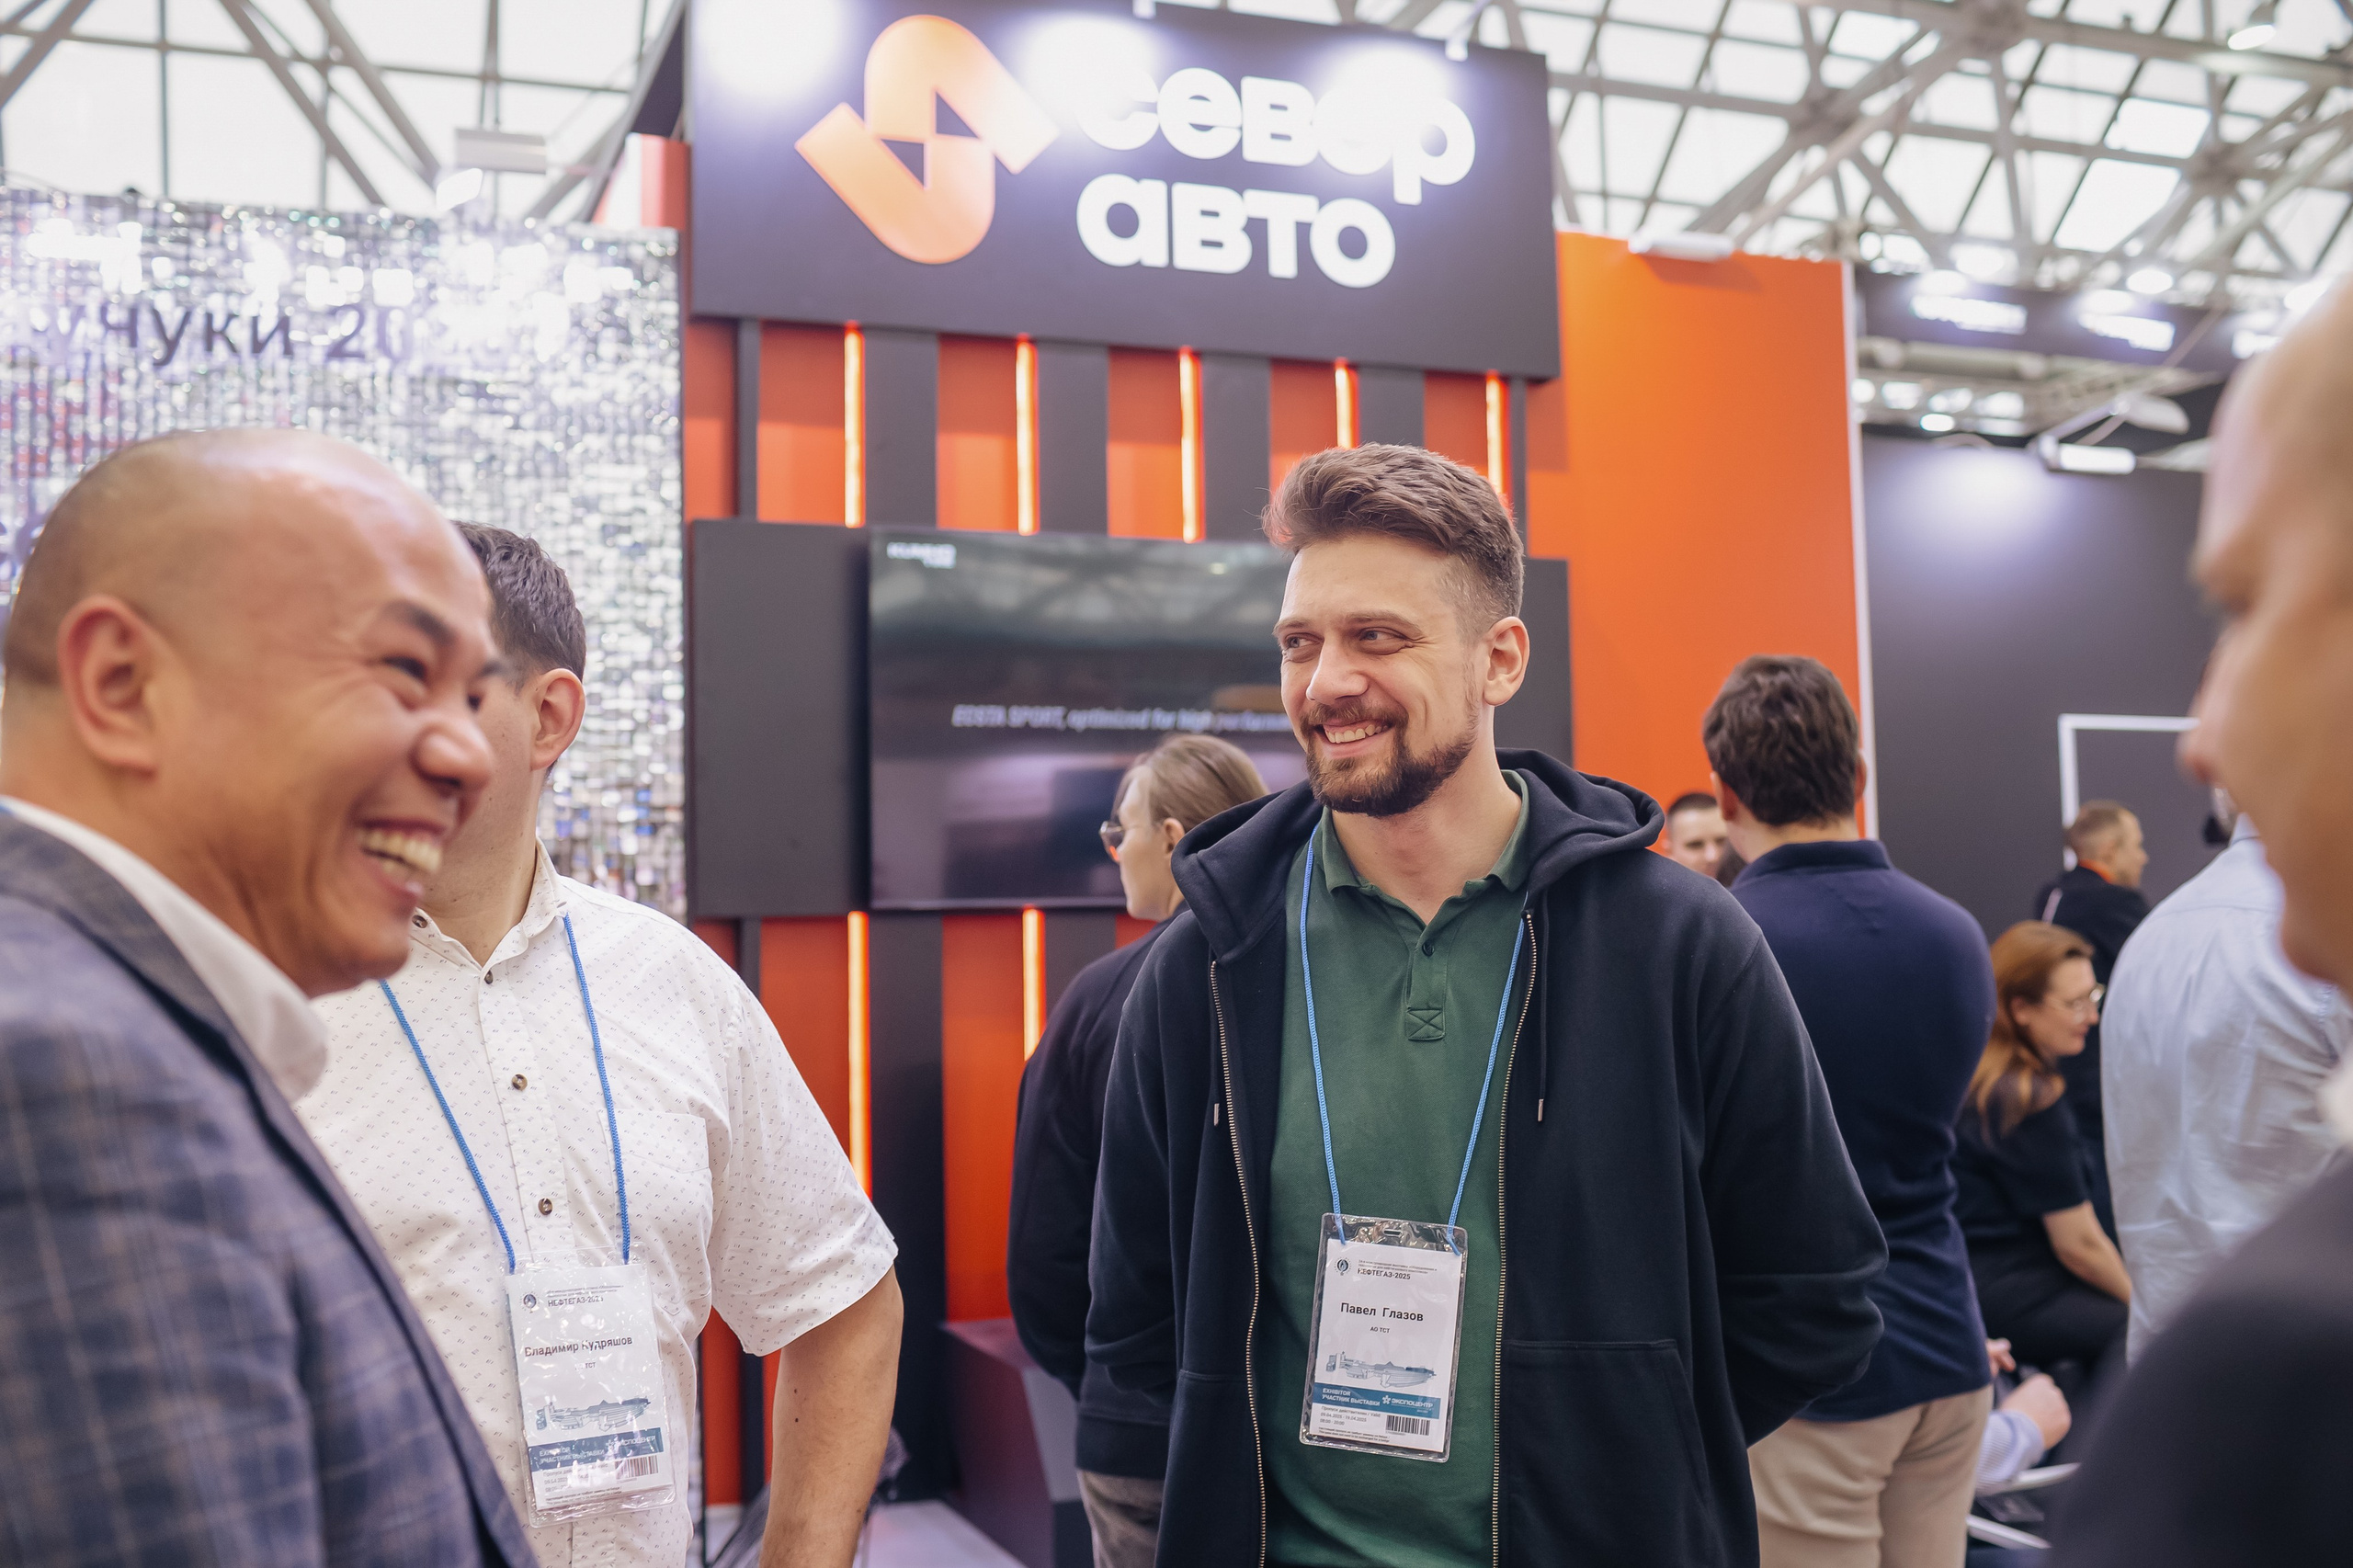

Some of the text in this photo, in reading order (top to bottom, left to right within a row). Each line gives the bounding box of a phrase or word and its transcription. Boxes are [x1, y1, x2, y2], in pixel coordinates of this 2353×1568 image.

[1075, 173, 1396, 289] авто
[1358, 1267, 1411, 1280] НЕФТЕГАЗ-2025
[1340, 1301, 1424, 1322] Павел Глазов
